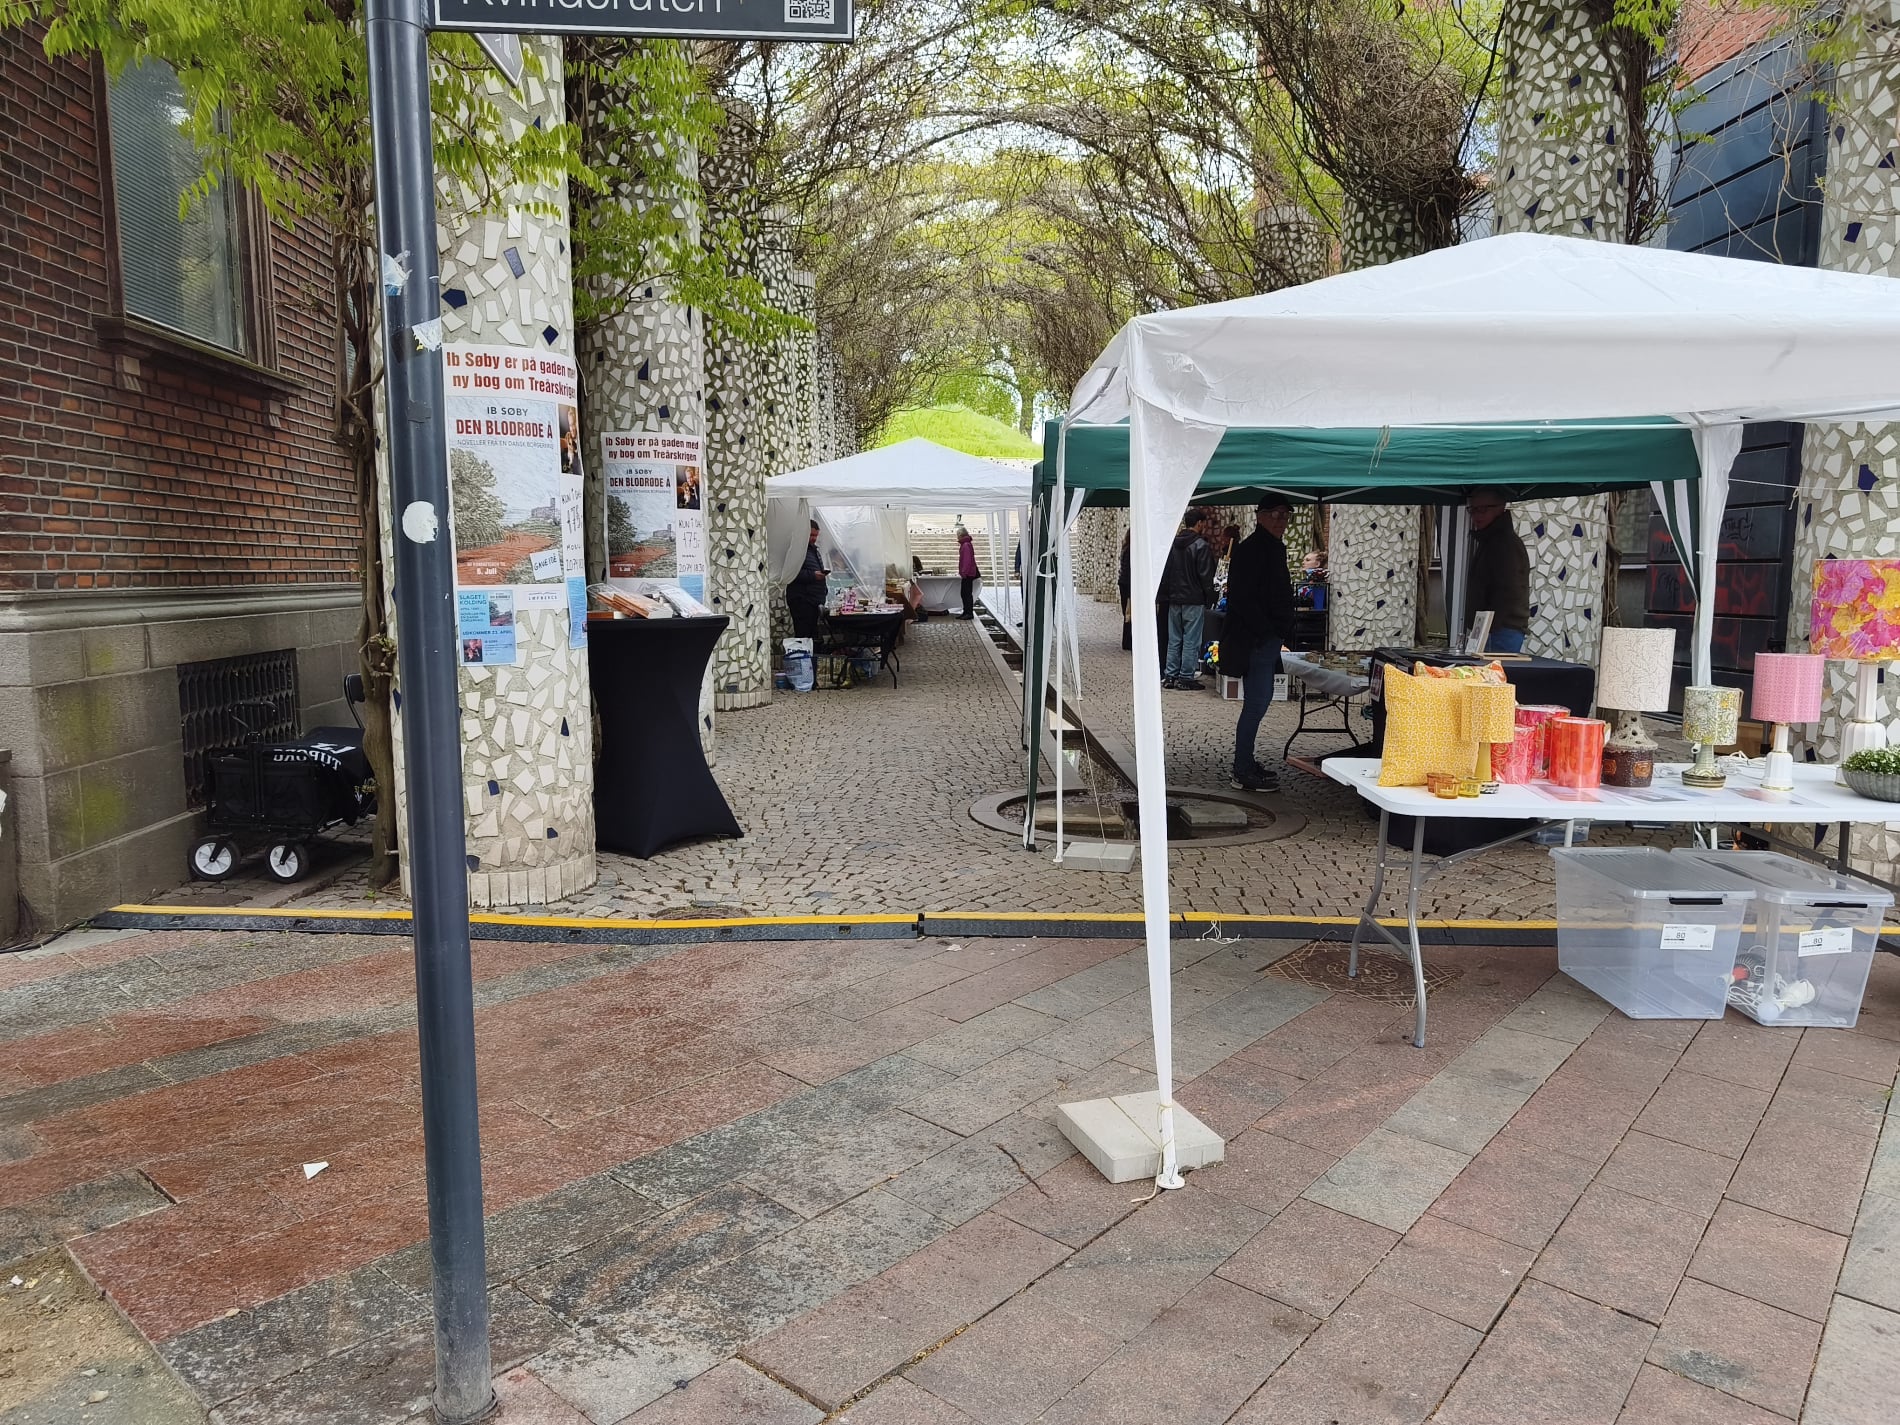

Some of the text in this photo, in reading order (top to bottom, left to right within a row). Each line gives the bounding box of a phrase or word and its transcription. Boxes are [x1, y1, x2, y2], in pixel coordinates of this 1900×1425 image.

[446, 352, 460, 367] Ib
[465, 352, 500, 370] Søby
[505, 357, 518, 369] er
[522, 357, 537, 372] på
[540, 360, 566, 377] gaden
[453, 375, 469, 389] ny
[474, 373, 500, 390] bog
[505, 377, 525, 390] om
[487, 406, 529, 416] IB SØBY
[456, 419, 482, 435] DEN
[486, 420, 544, 438] BLODRØDE
[605, 436, 699, 450] Ib Søby er på gaden med
[608, 451, 618, 459] ny
[620, 449, 635, 459] bog
[653, 449, 697, 461] Treårskrigen
[610, 478, 624, 487] DEN
[626, 478, 664, 487] BLODRØDE
